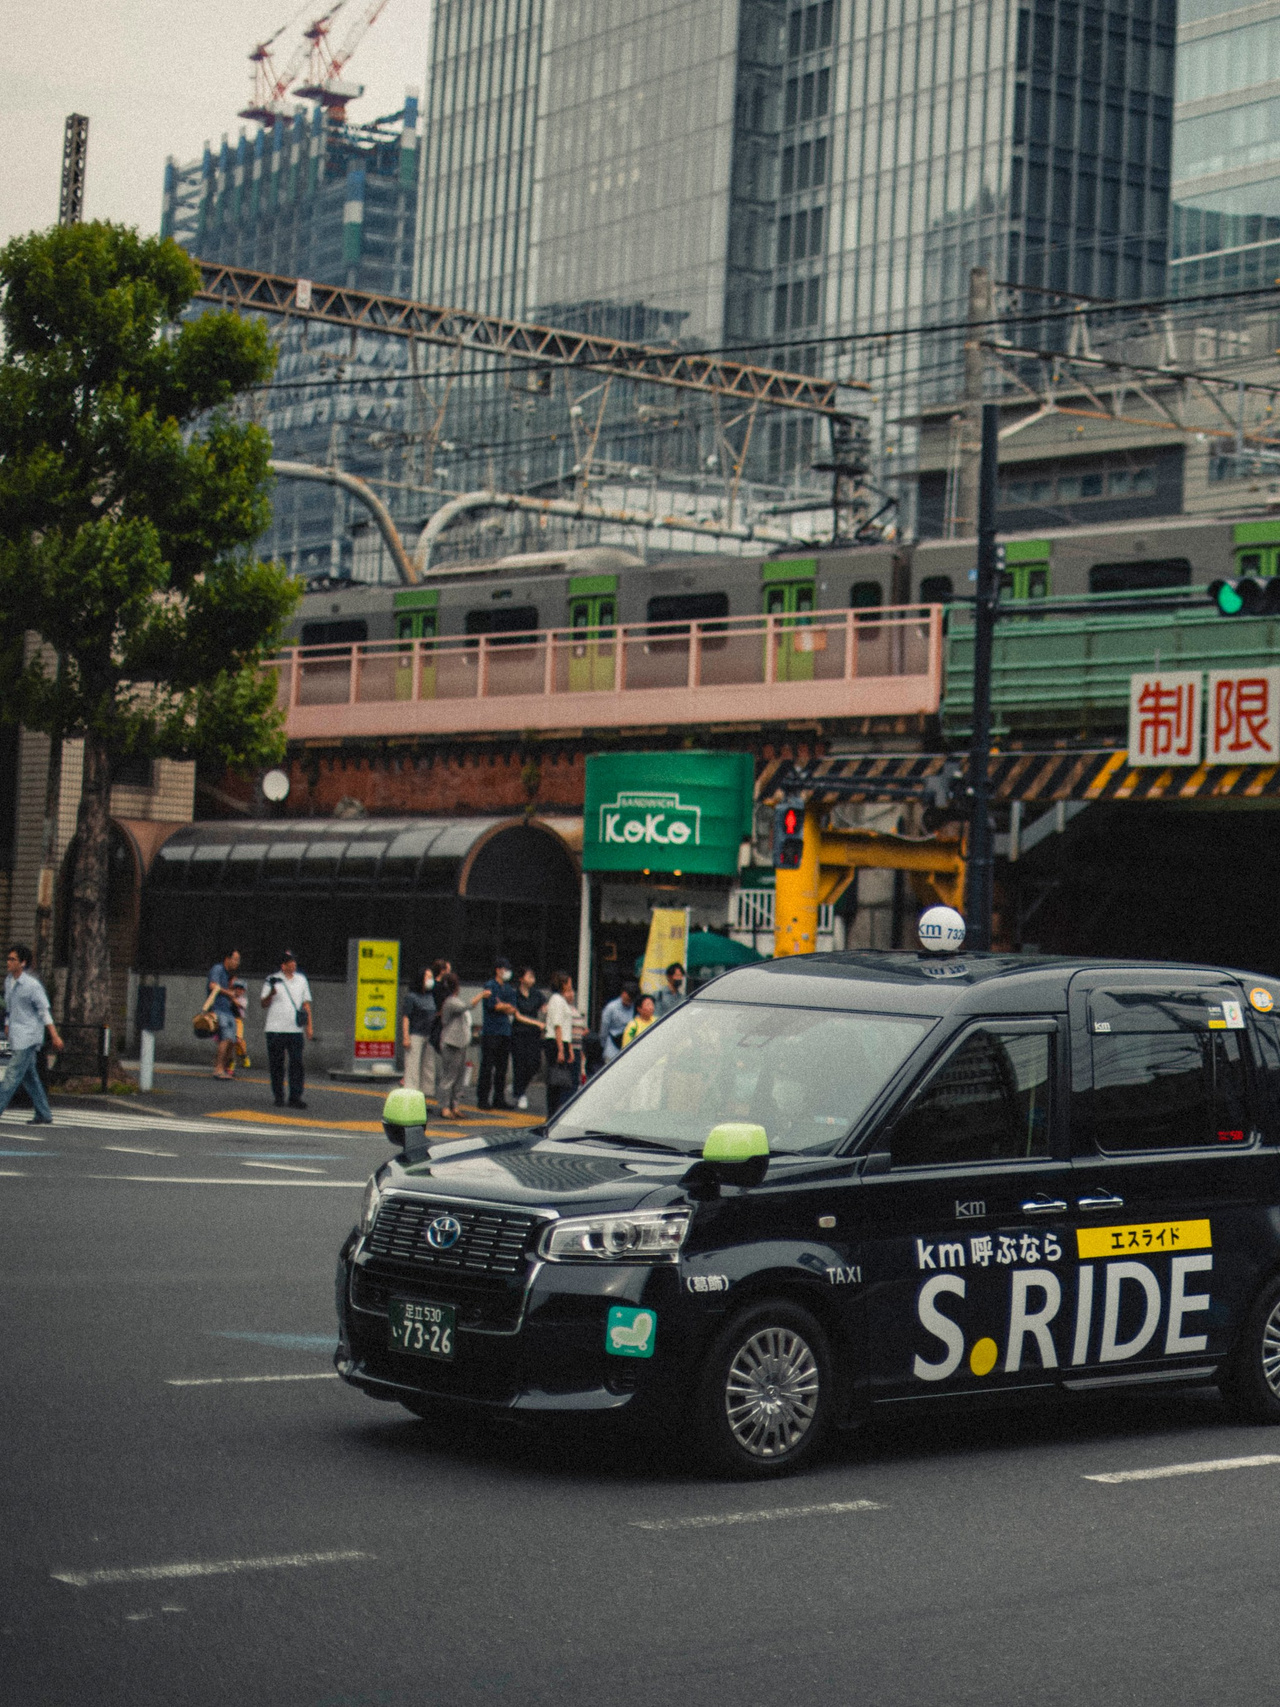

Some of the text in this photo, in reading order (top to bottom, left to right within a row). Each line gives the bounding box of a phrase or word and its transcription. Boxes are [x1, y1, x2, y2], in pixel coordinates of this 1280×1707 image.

[955, 1200, 986, 1217] km
[1111, 1227, 1180, 1249] エスライド
[917, 1233, 1063, 1269] km 呼ぶなら
[826, 1266, 862, 1284] TAXI
[913, 1254, 1213, 1381] S.RIDE
